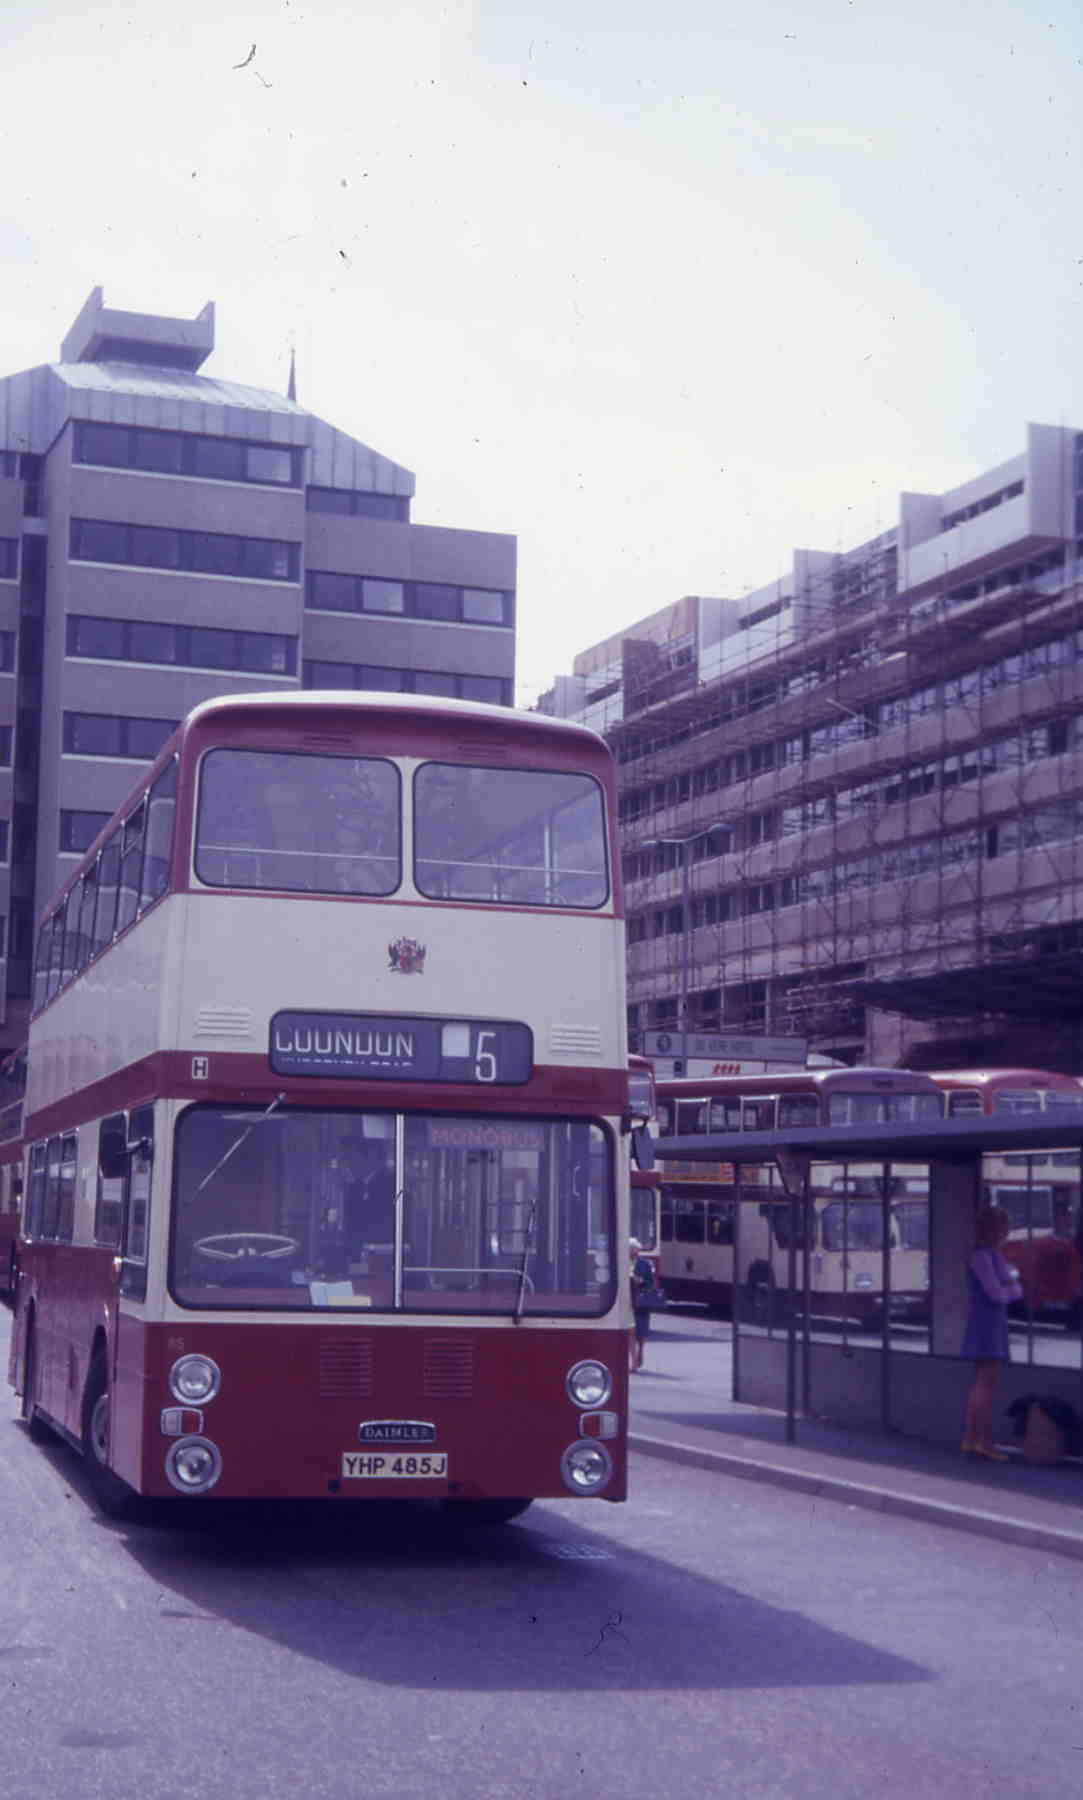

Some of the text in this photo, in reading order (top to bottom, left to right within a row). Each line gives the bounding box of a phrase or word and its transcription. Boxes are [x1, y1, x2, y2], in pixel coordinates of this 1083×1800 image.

[475, 1031, 497, 1082] 5
[193, 1058, 207, 1078] H
[344, 1457, 446, 1475] YHP 485J
